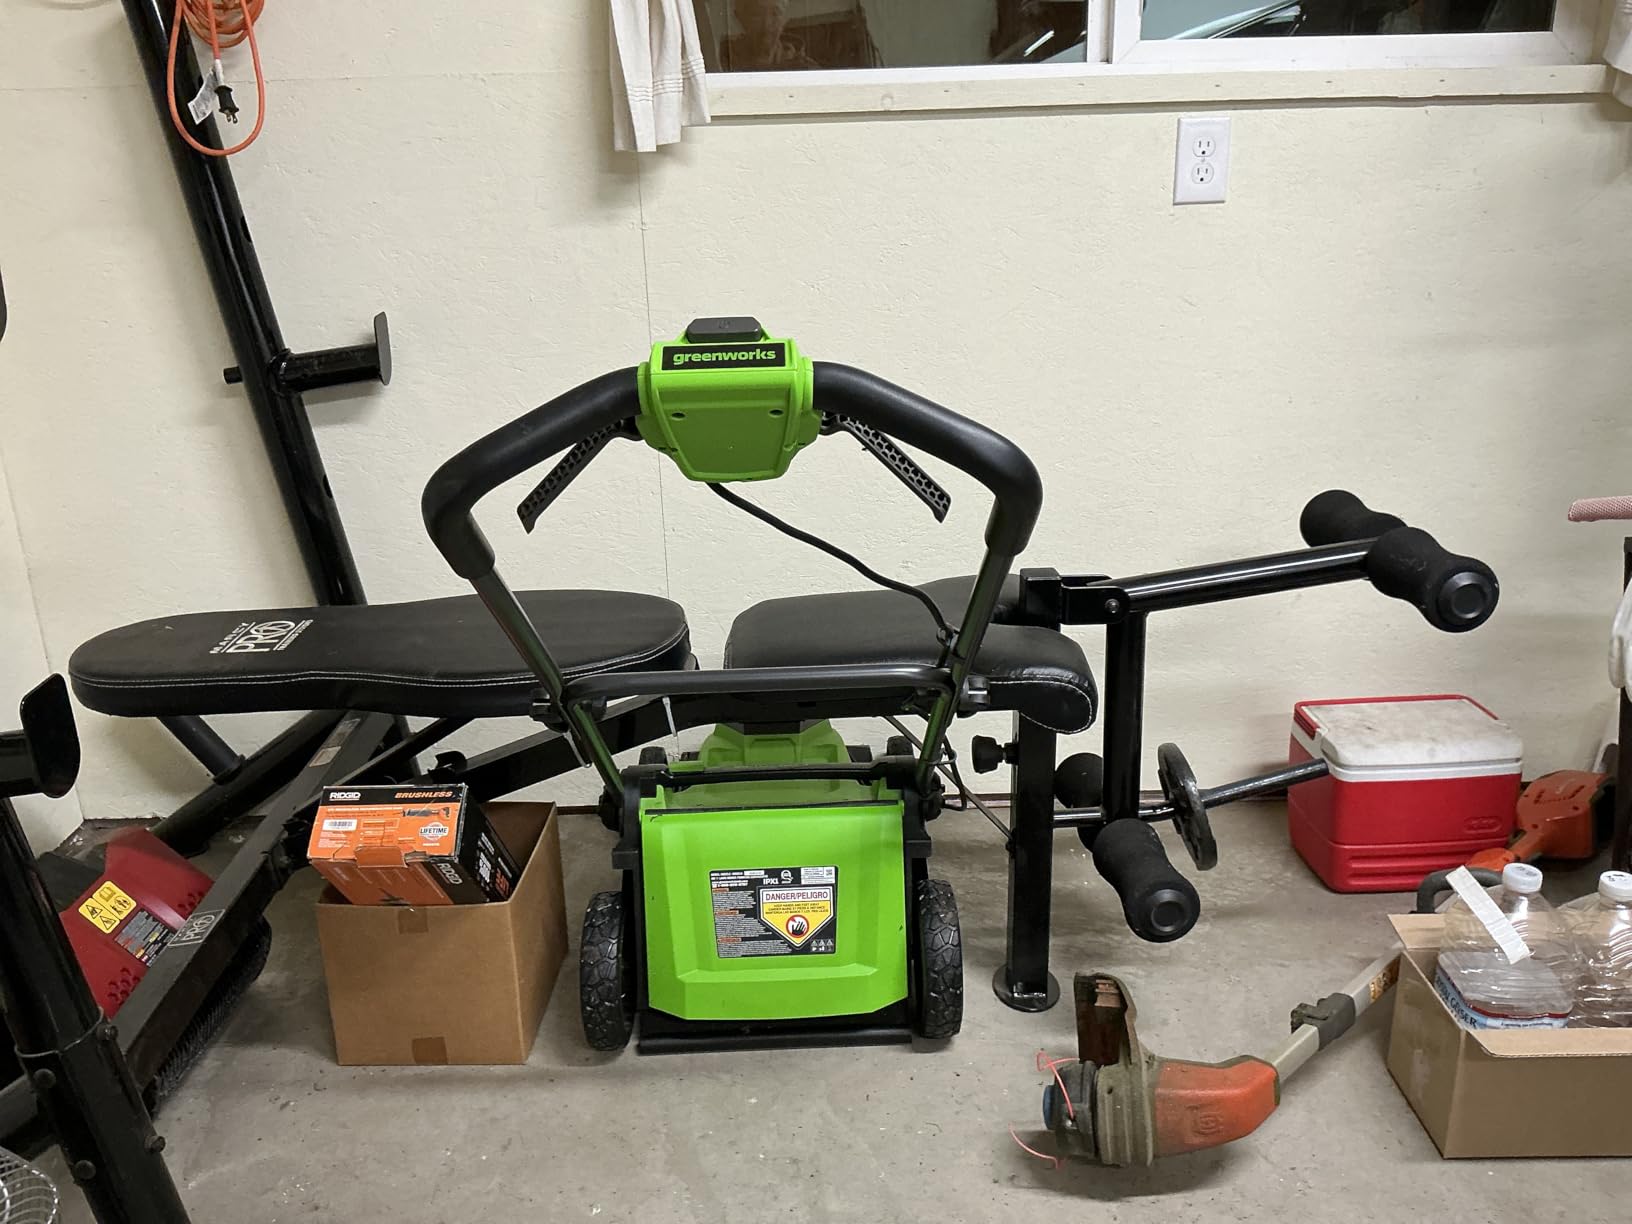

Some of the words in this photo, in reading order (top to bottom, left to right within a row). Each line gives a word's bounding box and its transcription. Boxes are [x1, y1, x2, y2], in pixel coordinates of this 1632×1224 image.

[673, 348, 776, 365] greenworks
[226, 620, 296, 653] PRO
[329, 791, 361, 799] RIDGID
[395, 791, 453, 799] BRUSHLESS
[437, 863, 463, 885] RIDGID
[765, 891, 828, 901] DANGER/PELIGRO
